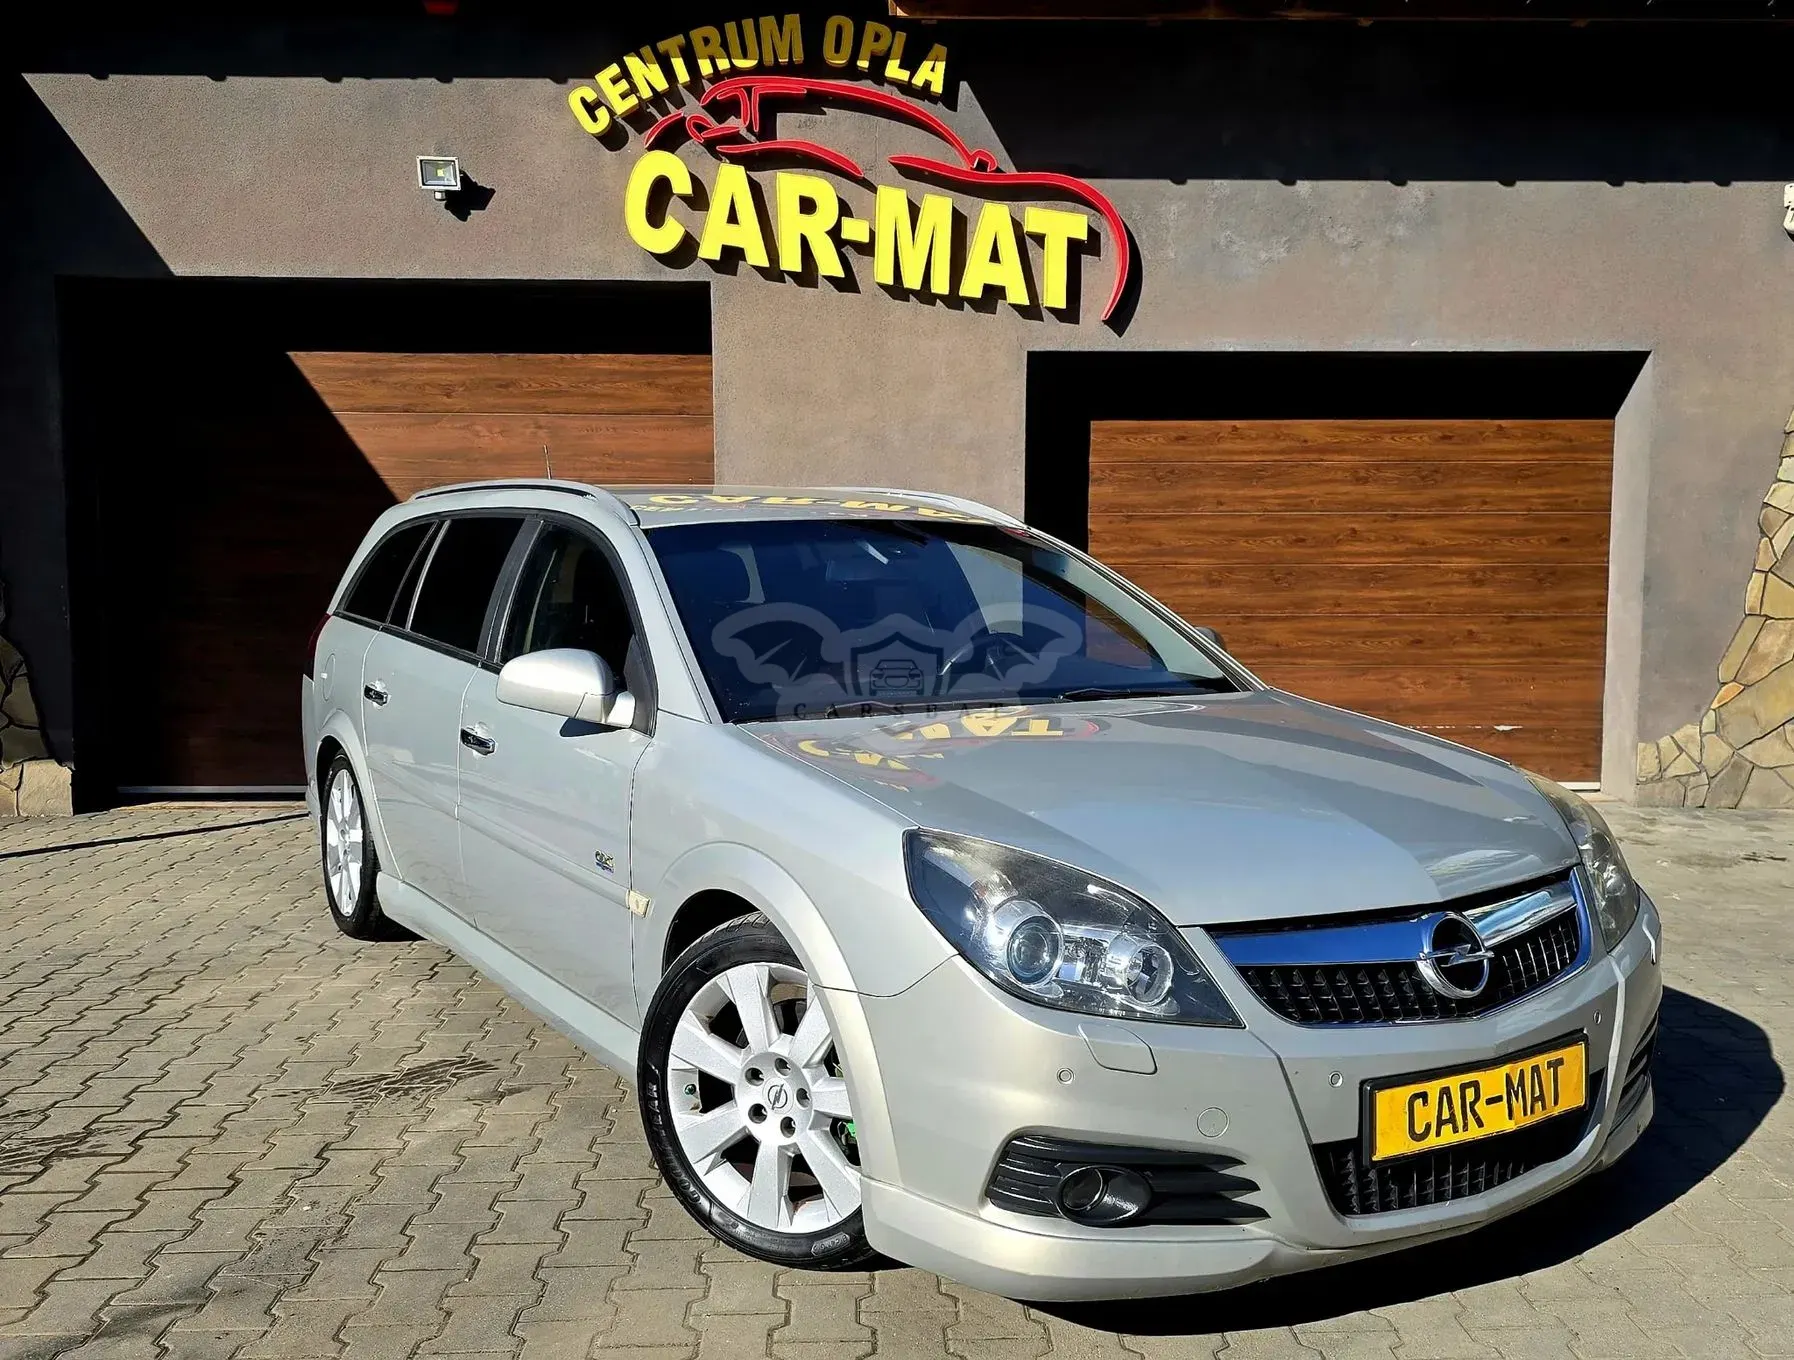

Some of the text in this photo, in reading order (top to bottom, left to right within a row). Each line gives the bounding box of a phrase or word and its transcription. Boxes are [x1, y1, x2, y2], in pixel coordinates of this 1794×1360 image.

[565, 13, 948, 137] CENTRUM OPLA
[624, 149, 1088, 309] CAR-MAT
[1407, 1057, 1565, 1143] CAR-MAT
